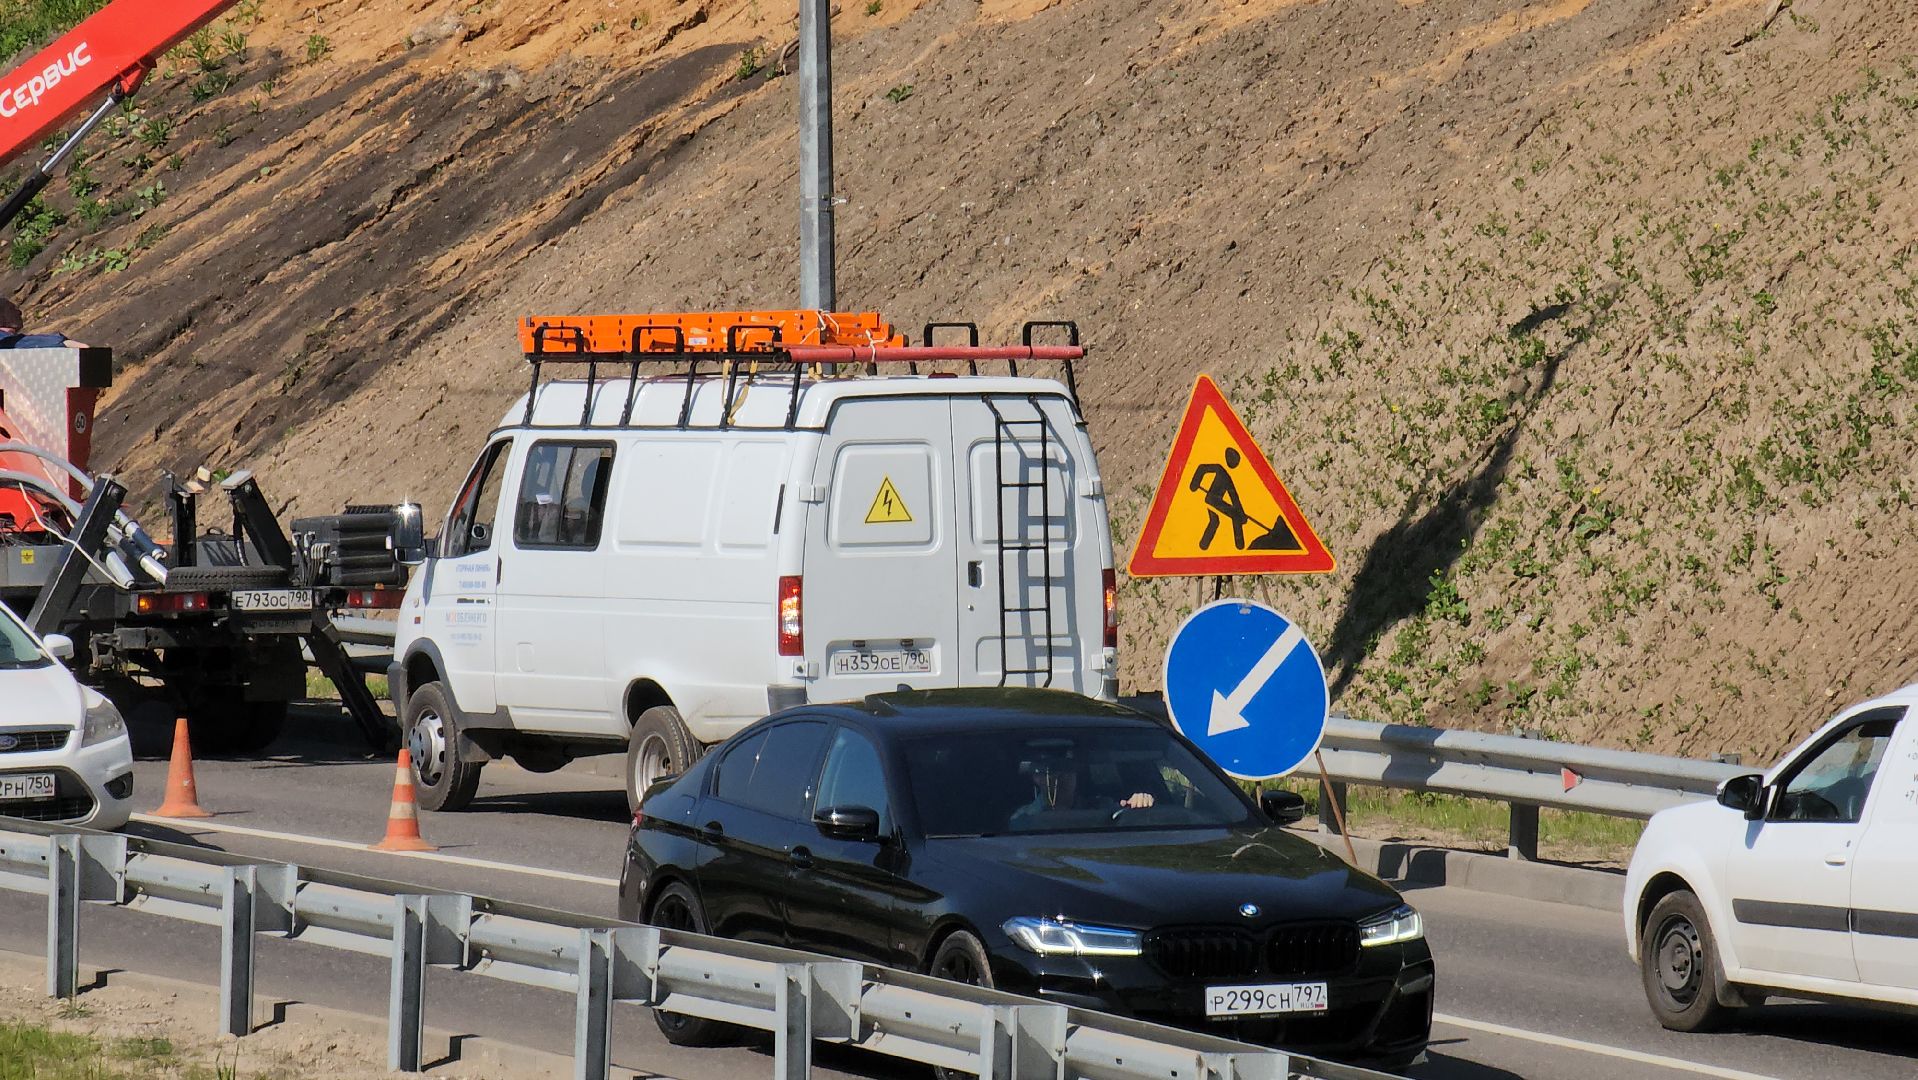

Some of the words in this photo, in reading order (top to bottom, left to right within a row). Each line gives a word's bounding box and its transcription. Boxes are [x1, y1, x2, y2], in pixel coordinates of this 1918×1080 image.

[235, 593, 288, 608] Е793ОС
[289, 592, 308, 603] 790
[840, 654, 901, 672] Н359ОЕ
[903, 652, 926, 666] 790
[28, 776, 51, 790] 750
[1214, 989, 1291, 1012] Р299СН
[1294, 985, 1322, 1003] 797
